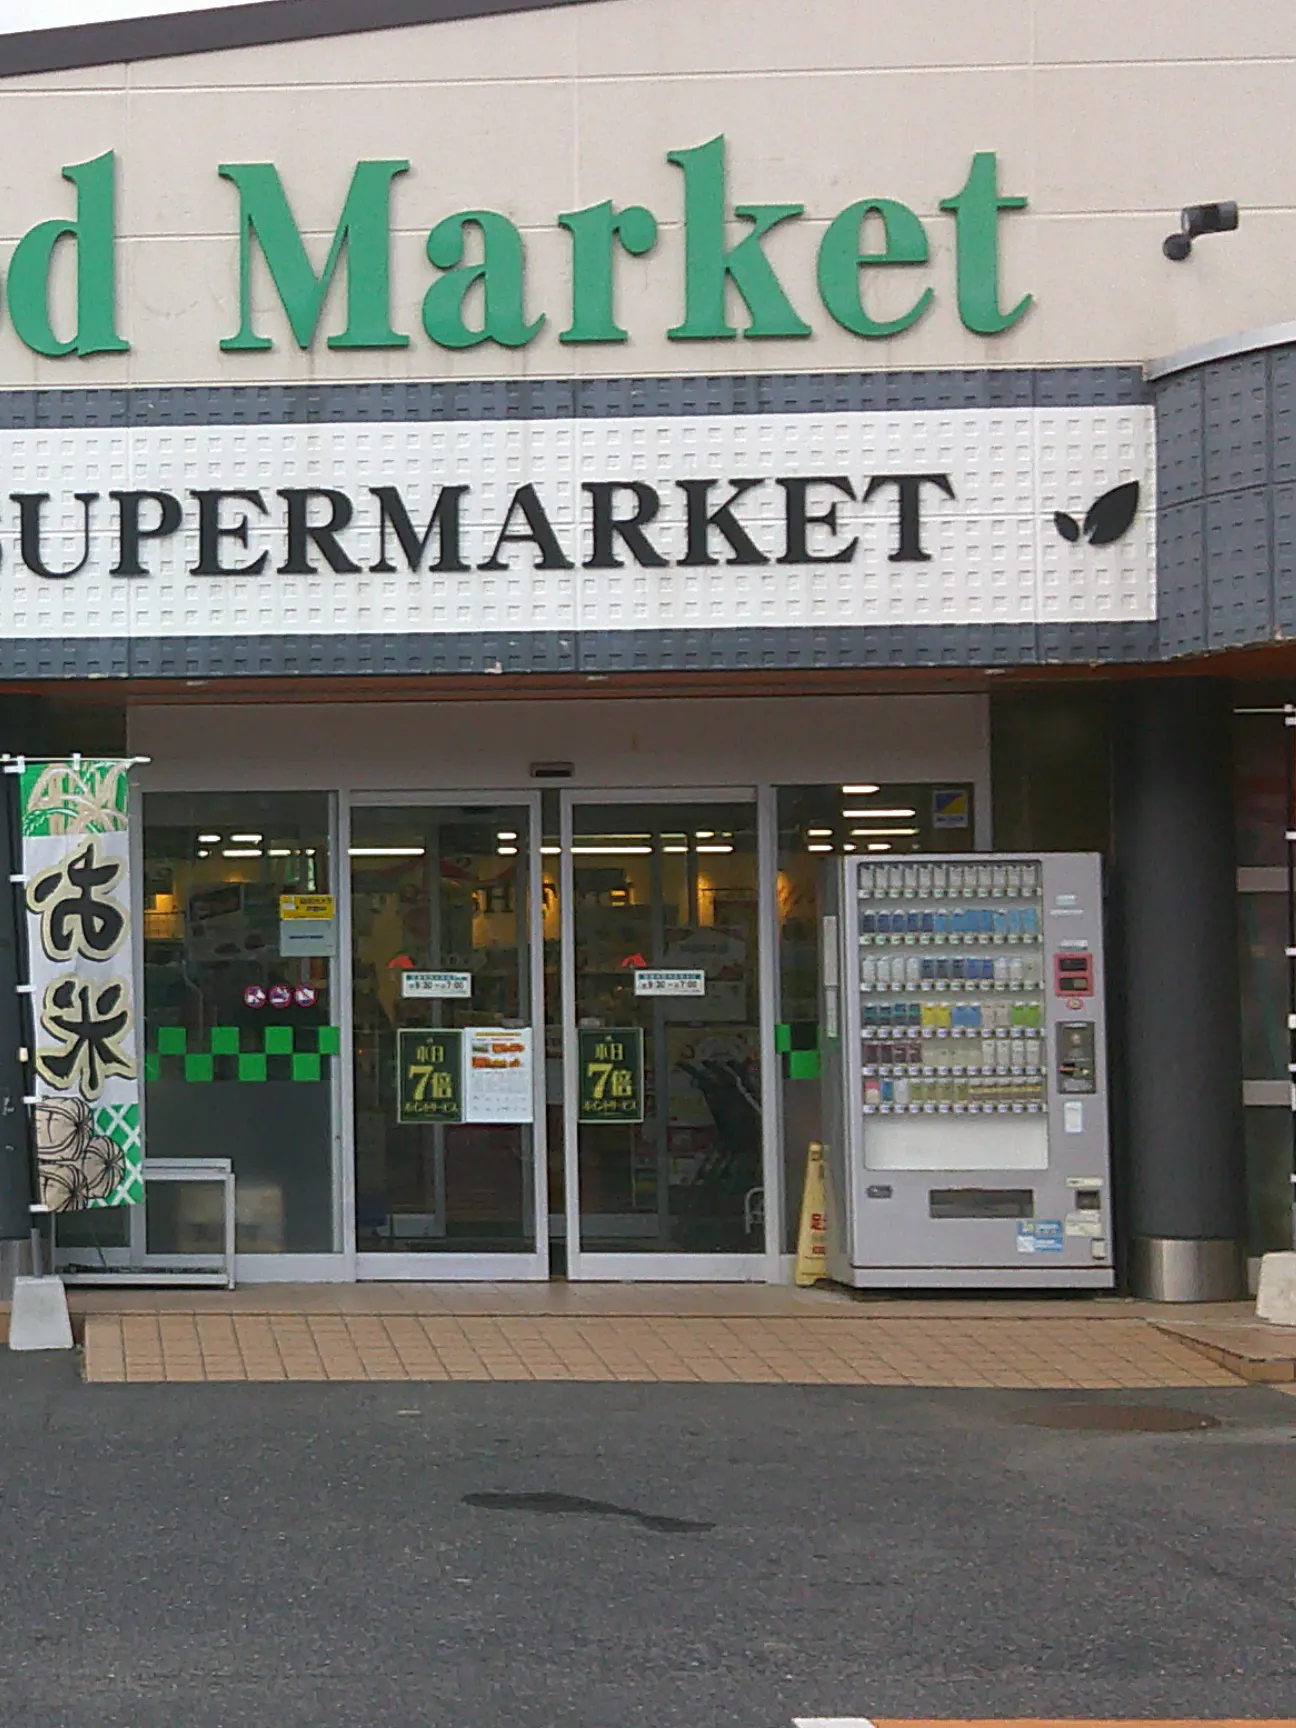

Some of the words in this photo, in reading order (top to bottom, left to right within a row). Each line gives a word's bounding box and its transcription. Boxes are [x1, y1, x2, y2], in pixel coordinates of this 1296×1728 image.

[217, 133, 1036, 352] Market
[26, 838, 138, 1101] お米
[409, 1065, 453, 1101] 7倍
[587, 1063, 632, 1099] 7倍
